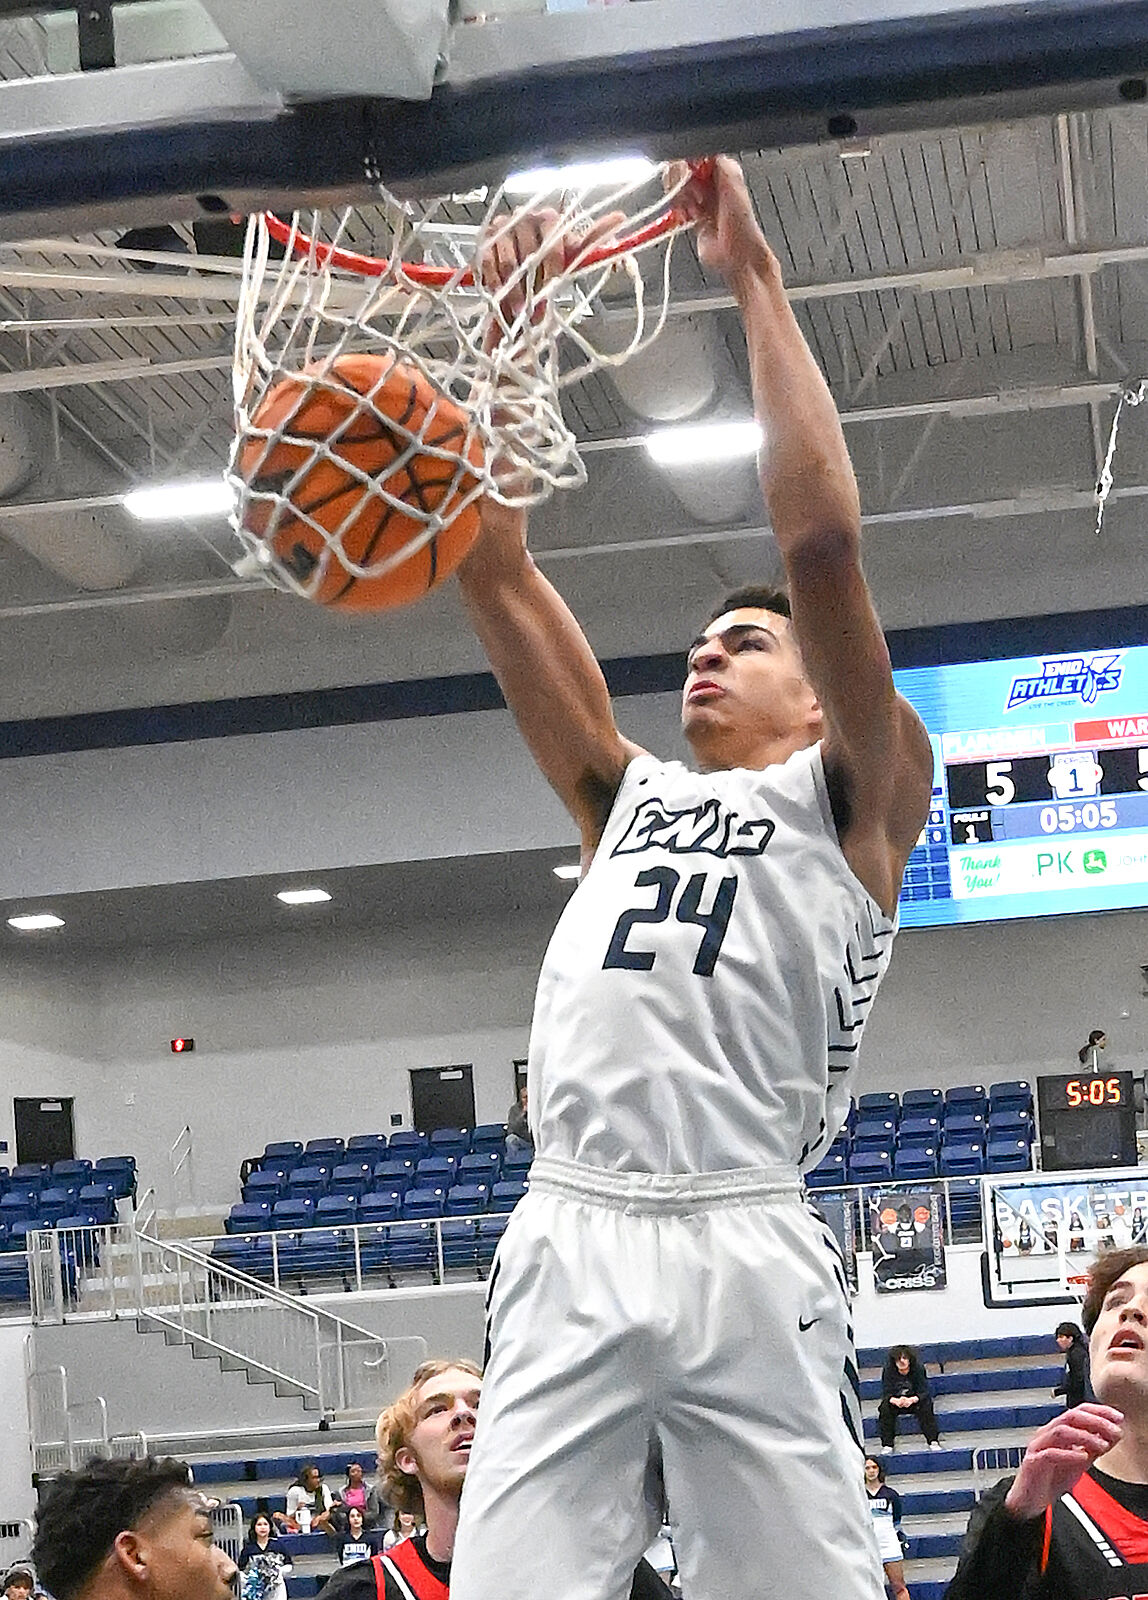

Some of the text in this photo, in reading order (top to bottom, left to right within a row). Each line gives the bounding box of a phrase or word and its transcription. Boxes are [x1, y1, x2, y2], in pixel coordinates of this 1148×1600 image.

[1010, 669, 1122, 700] ATHLETS
[985, 761, 1016, 806] 5
[1069, 768, 1083, 792] 1
[609, 797, 776, 859] ENID
[1040, 800, 1118, 833] 05:05
[965, 824, 980, 844] 1
[960, 854, 1001, 871] Thank
[1037, 851, 1073, 875] PK
[602, 866, 738, 977] 24
[1066, 1078, 1120, 1107] 5:05
